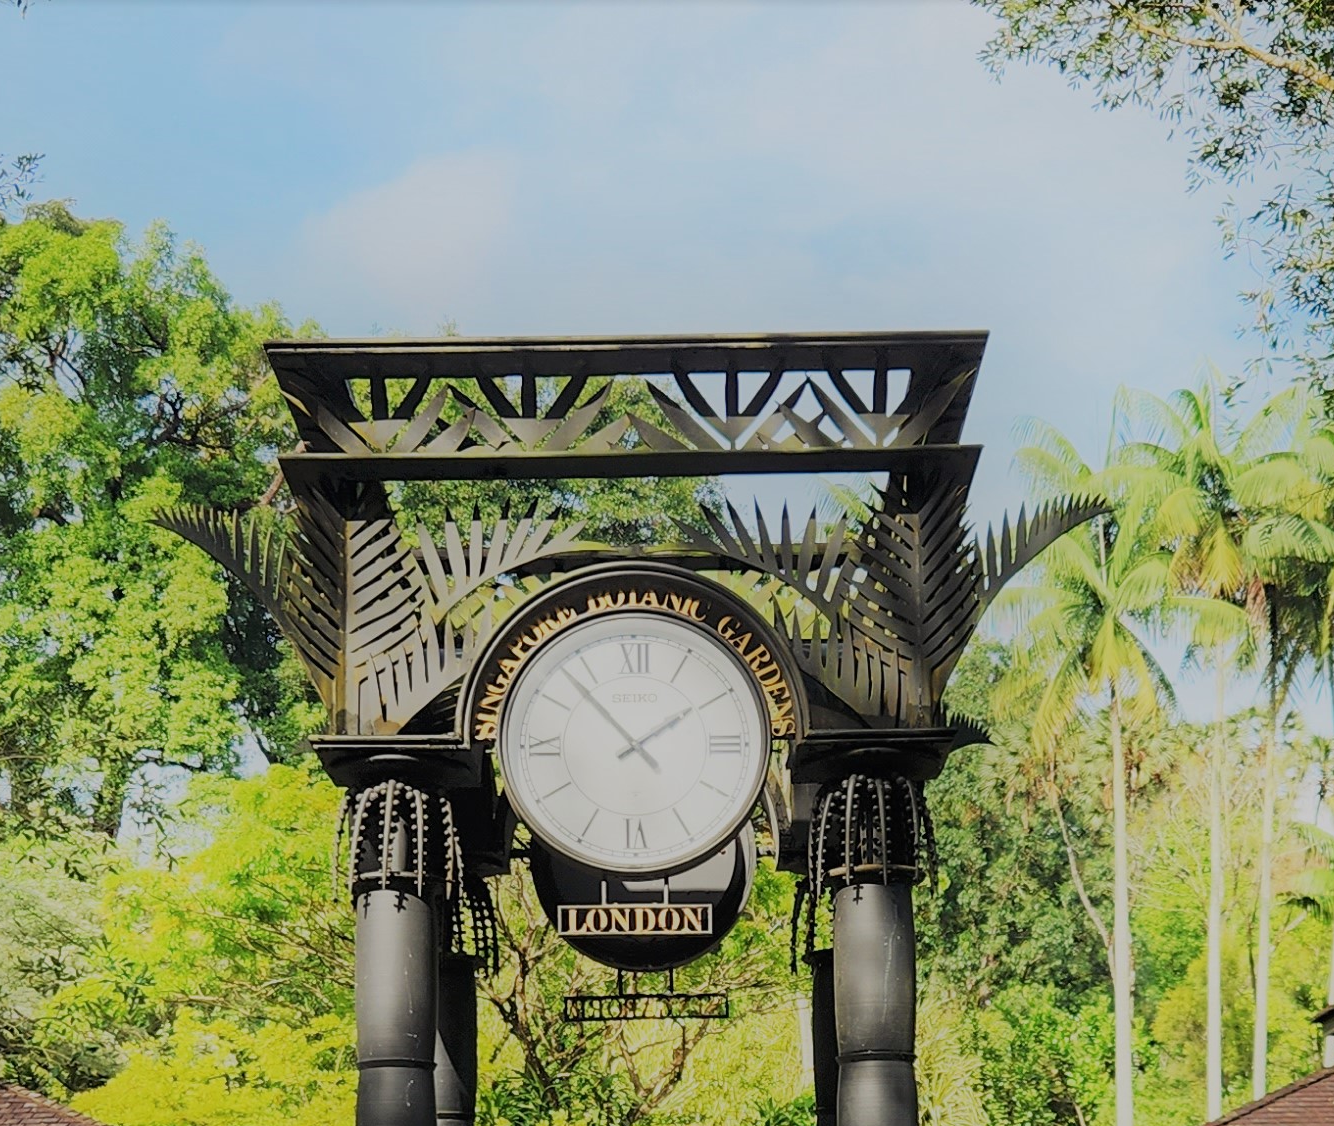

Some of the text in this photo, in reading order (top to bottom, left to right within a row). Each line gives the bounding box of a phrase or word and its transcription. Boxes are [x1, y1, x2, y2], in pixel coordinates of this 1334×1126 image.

[474, 586, 797, 741] SINGAPORE BOTANIC GARDENS
[611, 692, 658, 704] SEIKO
[567, 907, 703, 933] LONDON
